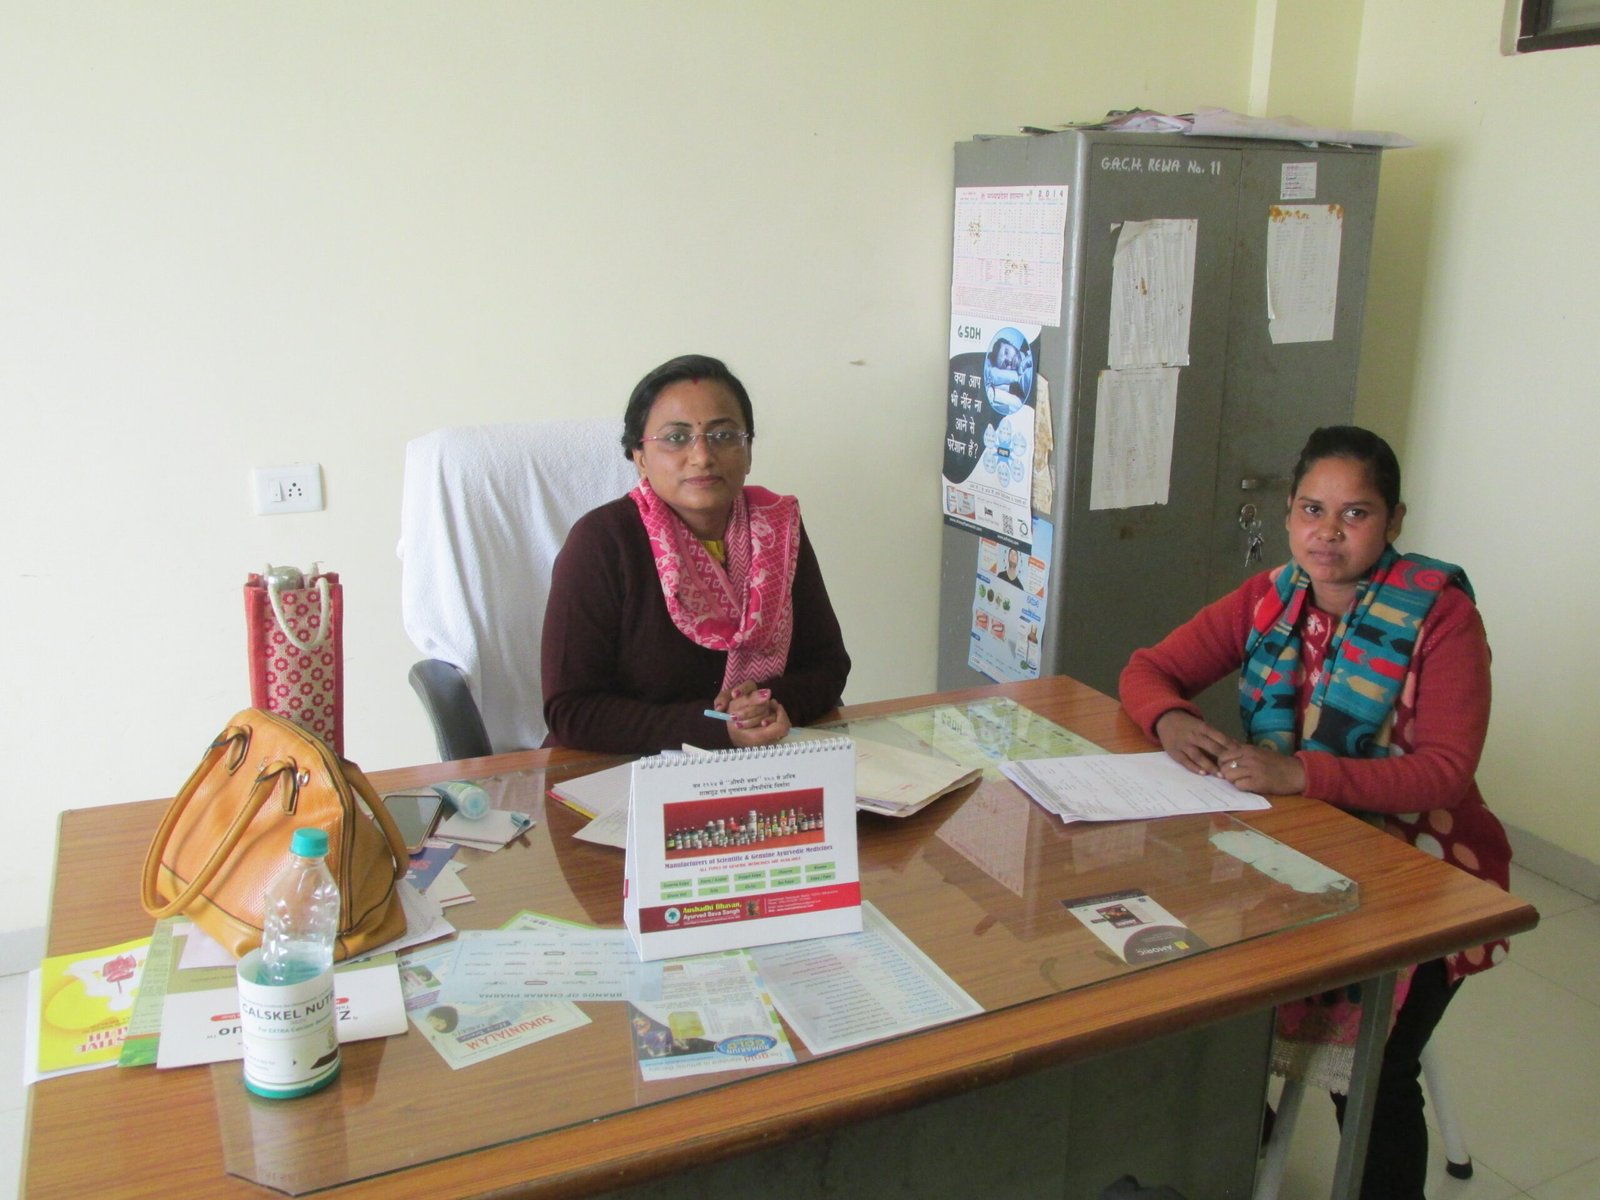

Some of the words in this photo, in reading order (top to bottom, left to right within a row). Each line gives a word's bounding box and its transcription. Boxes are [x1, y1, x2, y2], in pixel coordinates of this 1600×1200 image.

[1148, 158, 1181, 172] REWA
[1187, 160, 1206, 174] No.
[1211, 160, 1221, 175] 11
[953, 371, 967, 385] क्या
[968, 374, 981, 389] आप
[950, 389, 959, 407] भी
[974, 398, 983, 413] ना
[955, 413, 968, 432] आने
[969, 416, 976, 435] से
[946, 433, 966, 455] परेशान
[665, 859, 707, 869] Manufacturers
[717, 855, 743, 864] Scientific
[751, 851, 775, 859] Genuine
[777, 848, 804, 857] Ayurvedic
[806, 845, 833, 853] Medicines
[683, 904, 713, 914] Aushadhi
[715, 902, 742, 910] Bhavan,
[683, 912, 707, 921] Ayurved
[722, 908, 740, 916] Sangh
[242, 1002, 302, 1020] CALSKEL
[744, 1053, 769, 1063] gold
